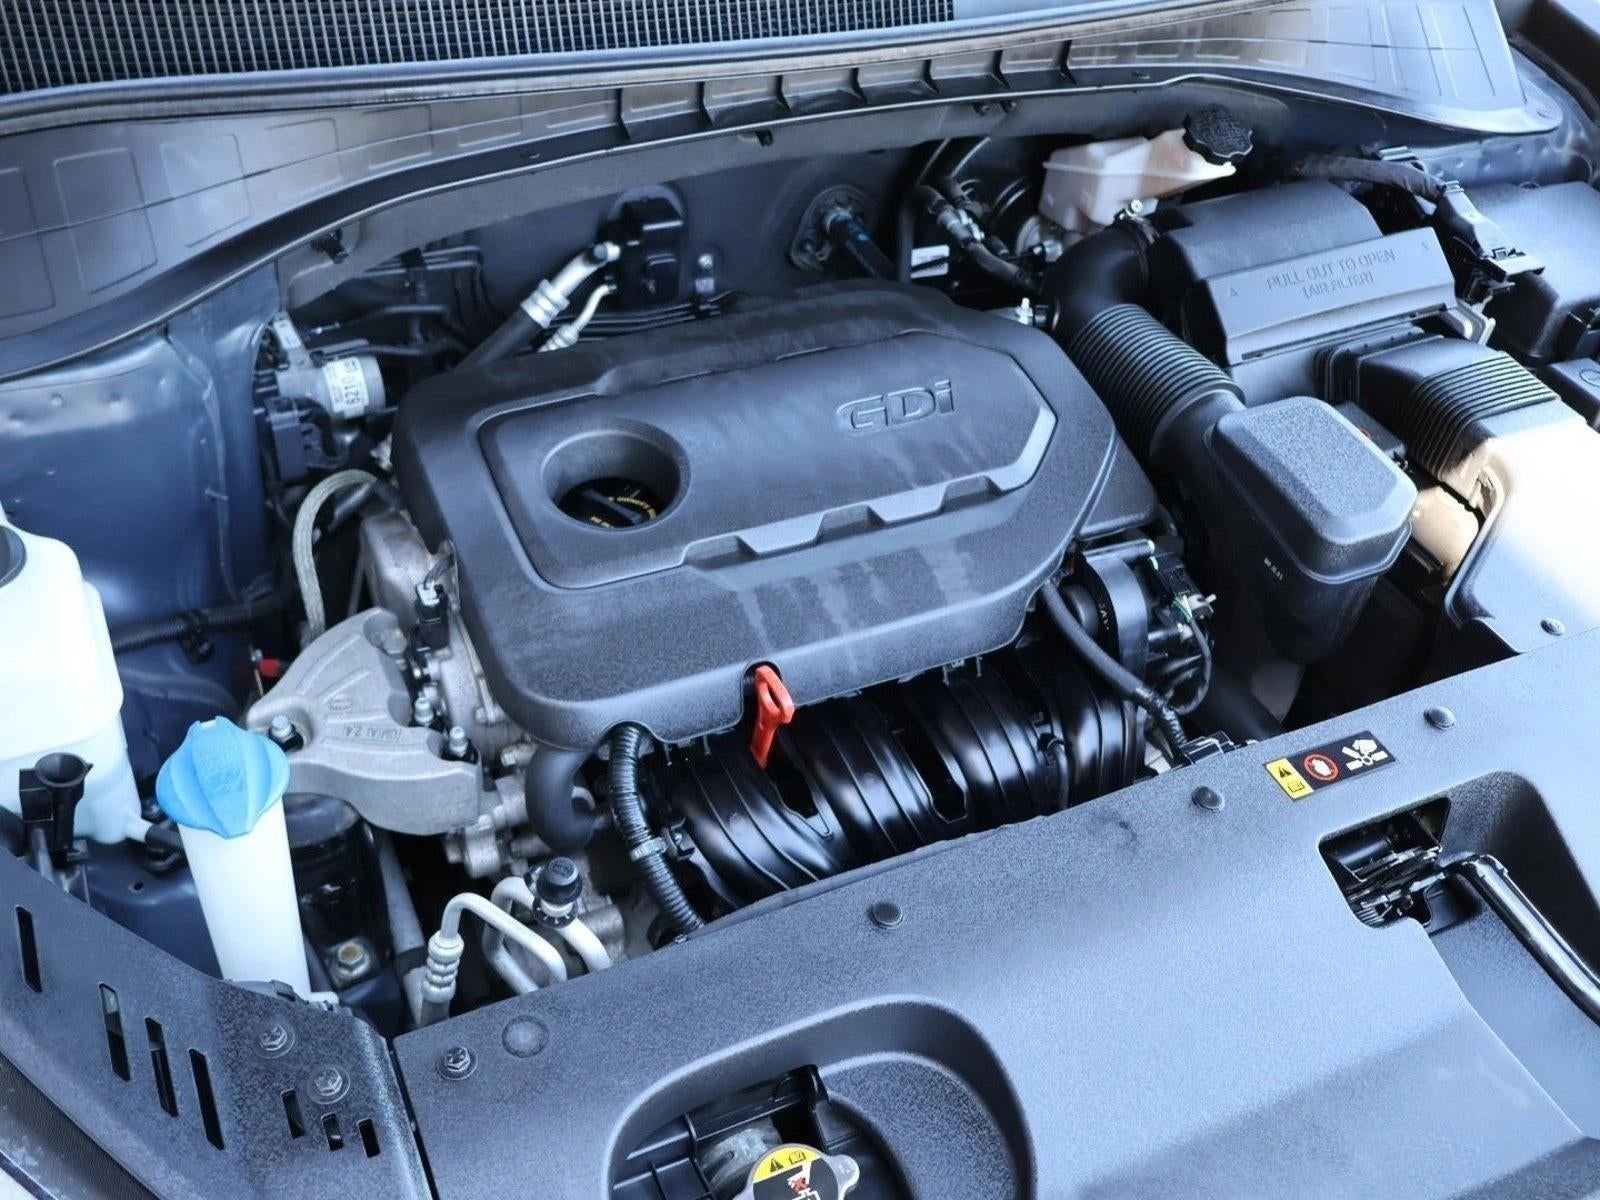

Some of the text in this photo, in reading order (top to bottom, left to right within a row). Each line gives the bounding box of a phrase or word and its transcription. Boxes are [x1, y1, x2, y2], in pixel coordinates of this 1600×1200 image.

[1266, 248, 1397, 291] PULL OUT TO OPEN
[836, 379, 955, 432] GDi
